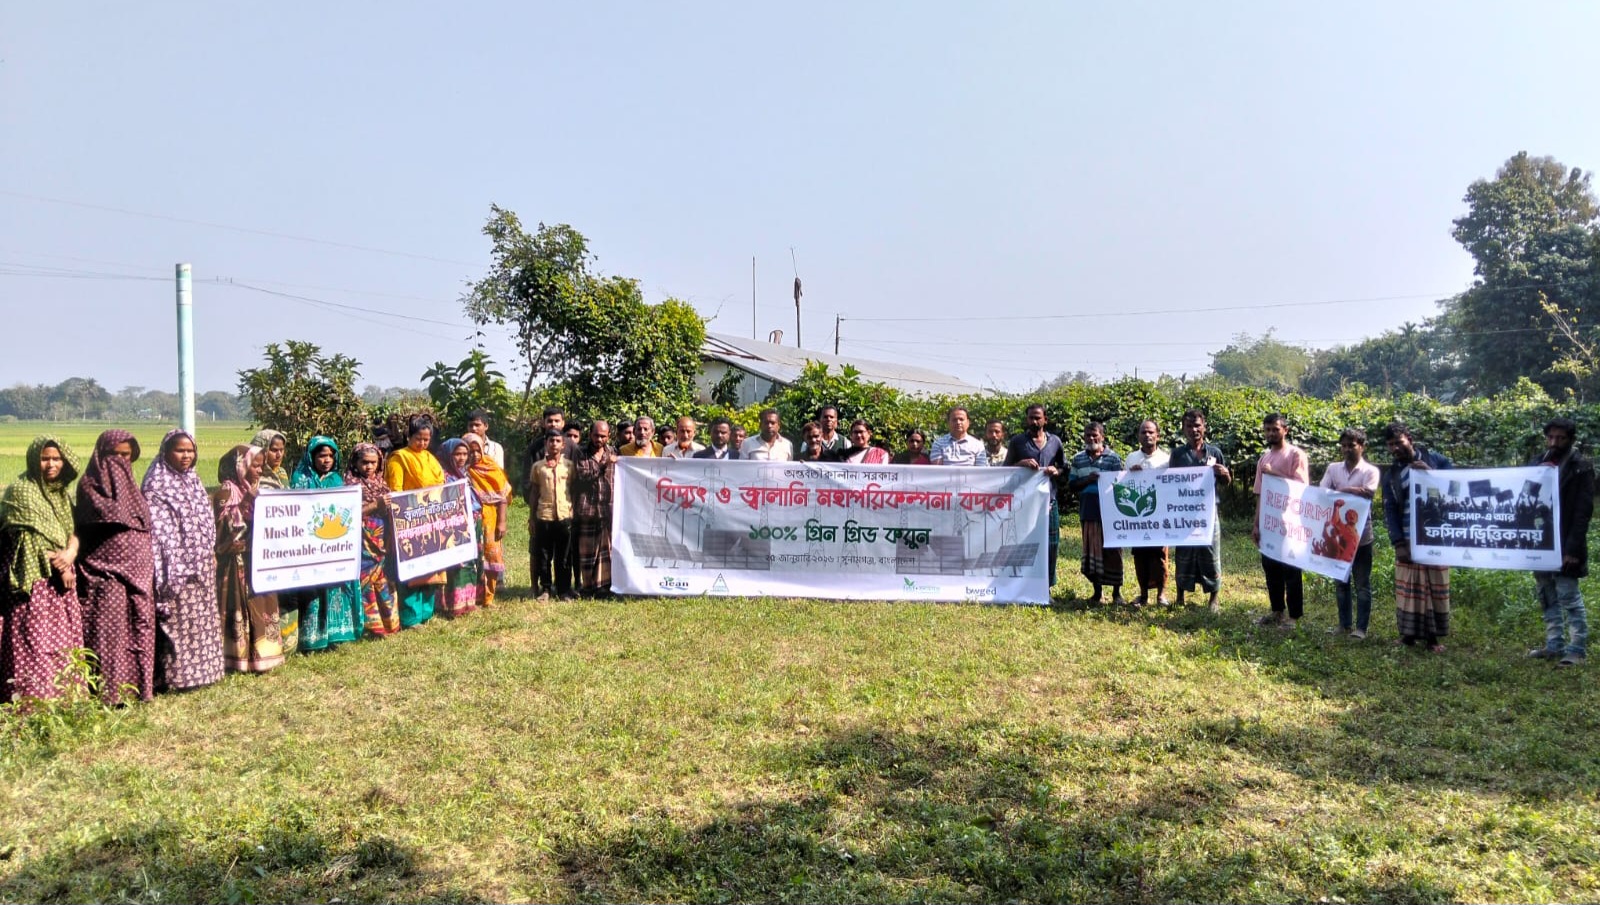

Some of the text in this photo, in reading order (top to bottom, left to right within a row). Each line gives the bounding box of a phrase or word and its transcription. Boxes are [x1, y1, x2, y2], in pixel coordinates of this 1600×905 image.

[862, 471, 899, 481] সরকার
[656, 477, 1014, 512] বিদ্যুৎ ও জ্বালানি মহাপরিকল্পনা বদলে
[1178, 487, 1205, 497] Must
[264, 504, 301, 519] EPSMP
[1166, 502, 1206, 513] Protect
[1265, 489, 1332, 521] REFORM
[1113, 517, 1207, 531] Climate & Lives
[1493, 512, 1516, 522] আর
[263, 525, 305, 540] Must Be
[748, 518, 932, 550] ১০০% গ্রিন গ্রিড করুন
[1264, 513, 1313, 543] EPSMP
[1424, 523, 1468, 539] ফসিল
[1518, 529, 1544, 543] নয়
[262, 540, 354, 560] Renewable-Centric
[965, 586, 997, 596] bwged
